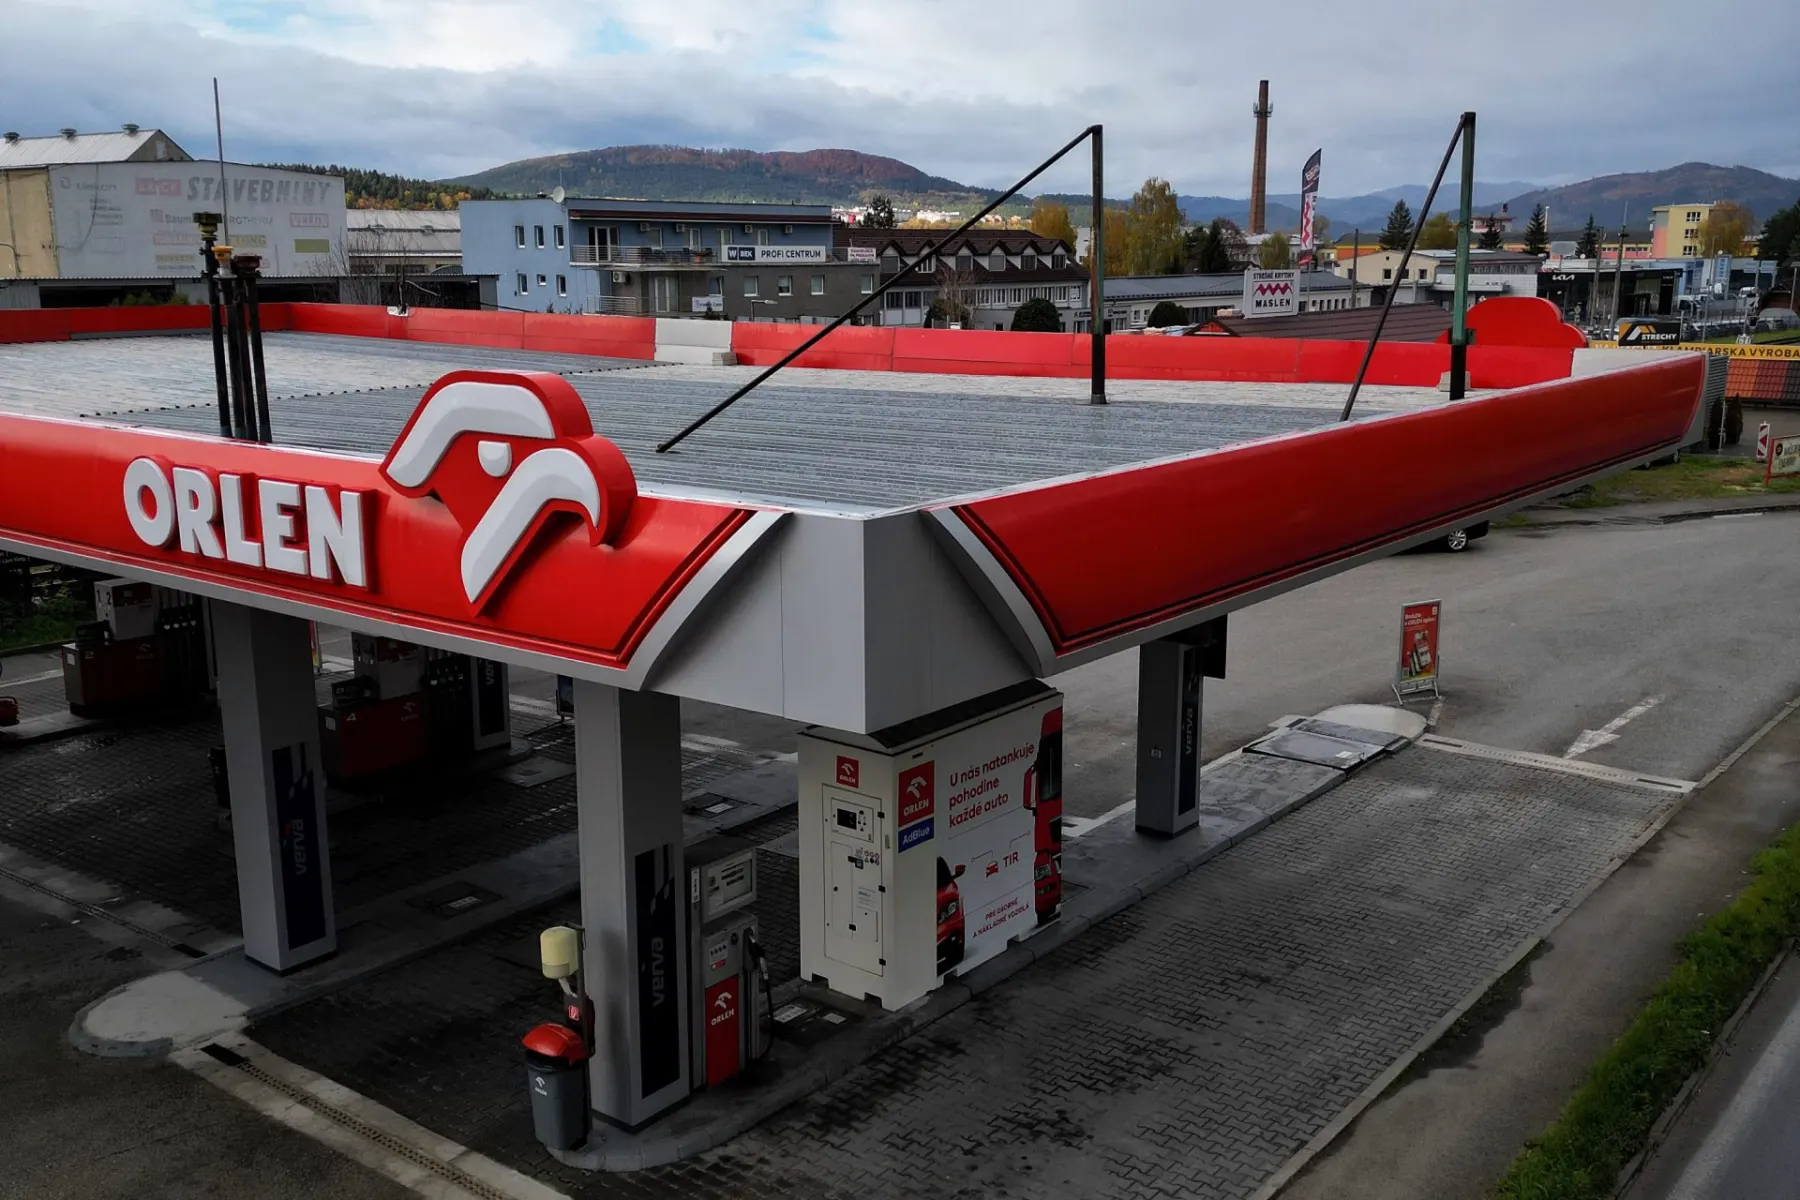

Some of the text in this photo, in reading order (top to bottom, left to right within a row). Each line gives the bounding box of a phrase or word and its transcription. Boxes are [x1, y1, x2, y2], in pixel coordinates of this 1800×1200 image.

[761, 249, 784, 258] PROFI
[786, 249, 821, 258] CENTRUM
[1255, 298, 1291, 308] MASLEN
[1641, 333, 1677, 341] STRECHY
[1750, 346, 1800, 358] VÝROBA
[123, 457, 367, 587] ORLEN
[85, 651, 95, 660] 2
[346, 712, 357, 722] 4
[1185, 707, 1193, 756] verva
[950, 742, 1035, 787] U nás natankuje
[839, 774, 856, 785] ORLEN
[949, 776, 1000, 811] pohodlne
[903, 798, 929, 816] ORLEN
[949, 792, 1009, 829] každé auto
[902, 827, 930, 845] AdBlue
[293, 818, 307, 876] verva
[1003, 851, 1019, 869] TIR
[985, 896, 1018, 921] PRE OSOBNÉ
[651, 937, 665, 1007] verva
[710, 1008, 735, 1026] ORLEN
